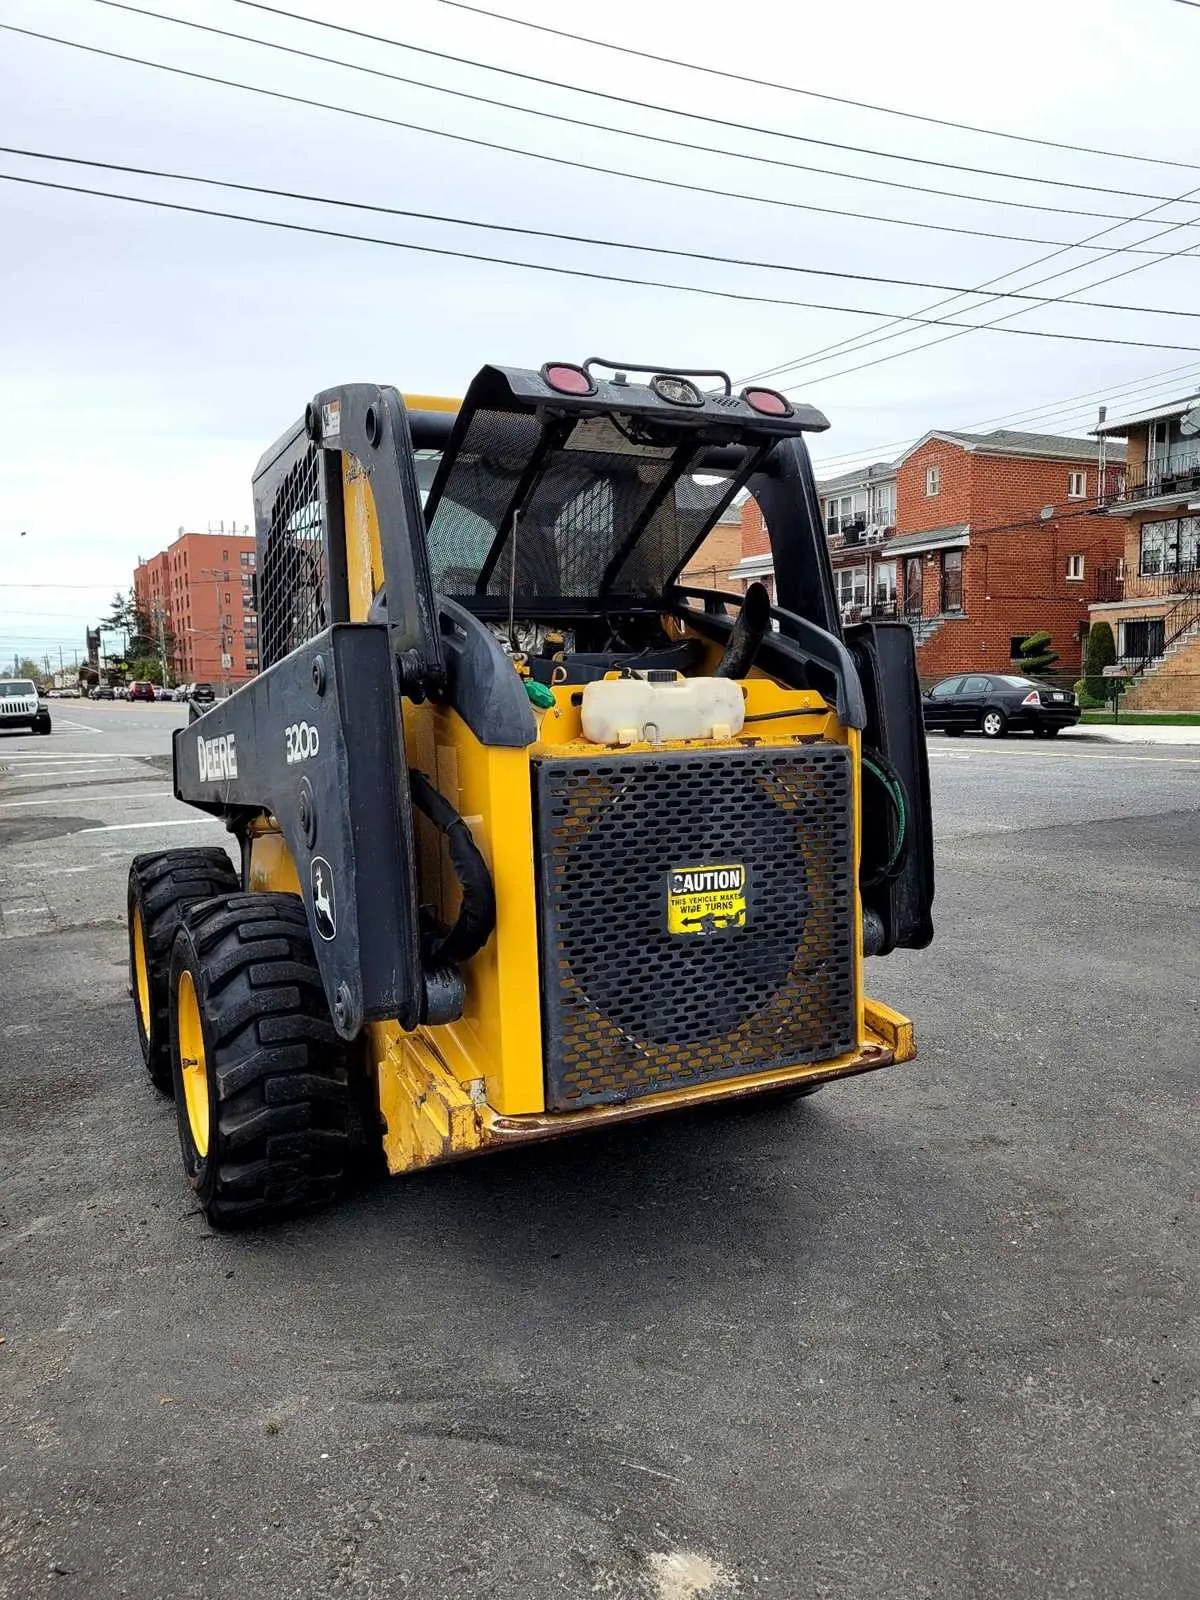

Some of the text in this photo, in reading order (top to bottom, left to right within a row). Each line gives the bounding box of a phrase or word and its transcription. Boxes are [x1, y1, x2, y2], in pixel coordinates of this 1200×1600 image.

[285, 721, 319, 764] 320D
[197, 733, 238, 782] DEERE
[672, 870, 740, 893] CAUTION
[672, 898, 686, 906] THIS
[690, 896, 717, 904] VEHICLE
[705, 902, 733, 911] TURNS
